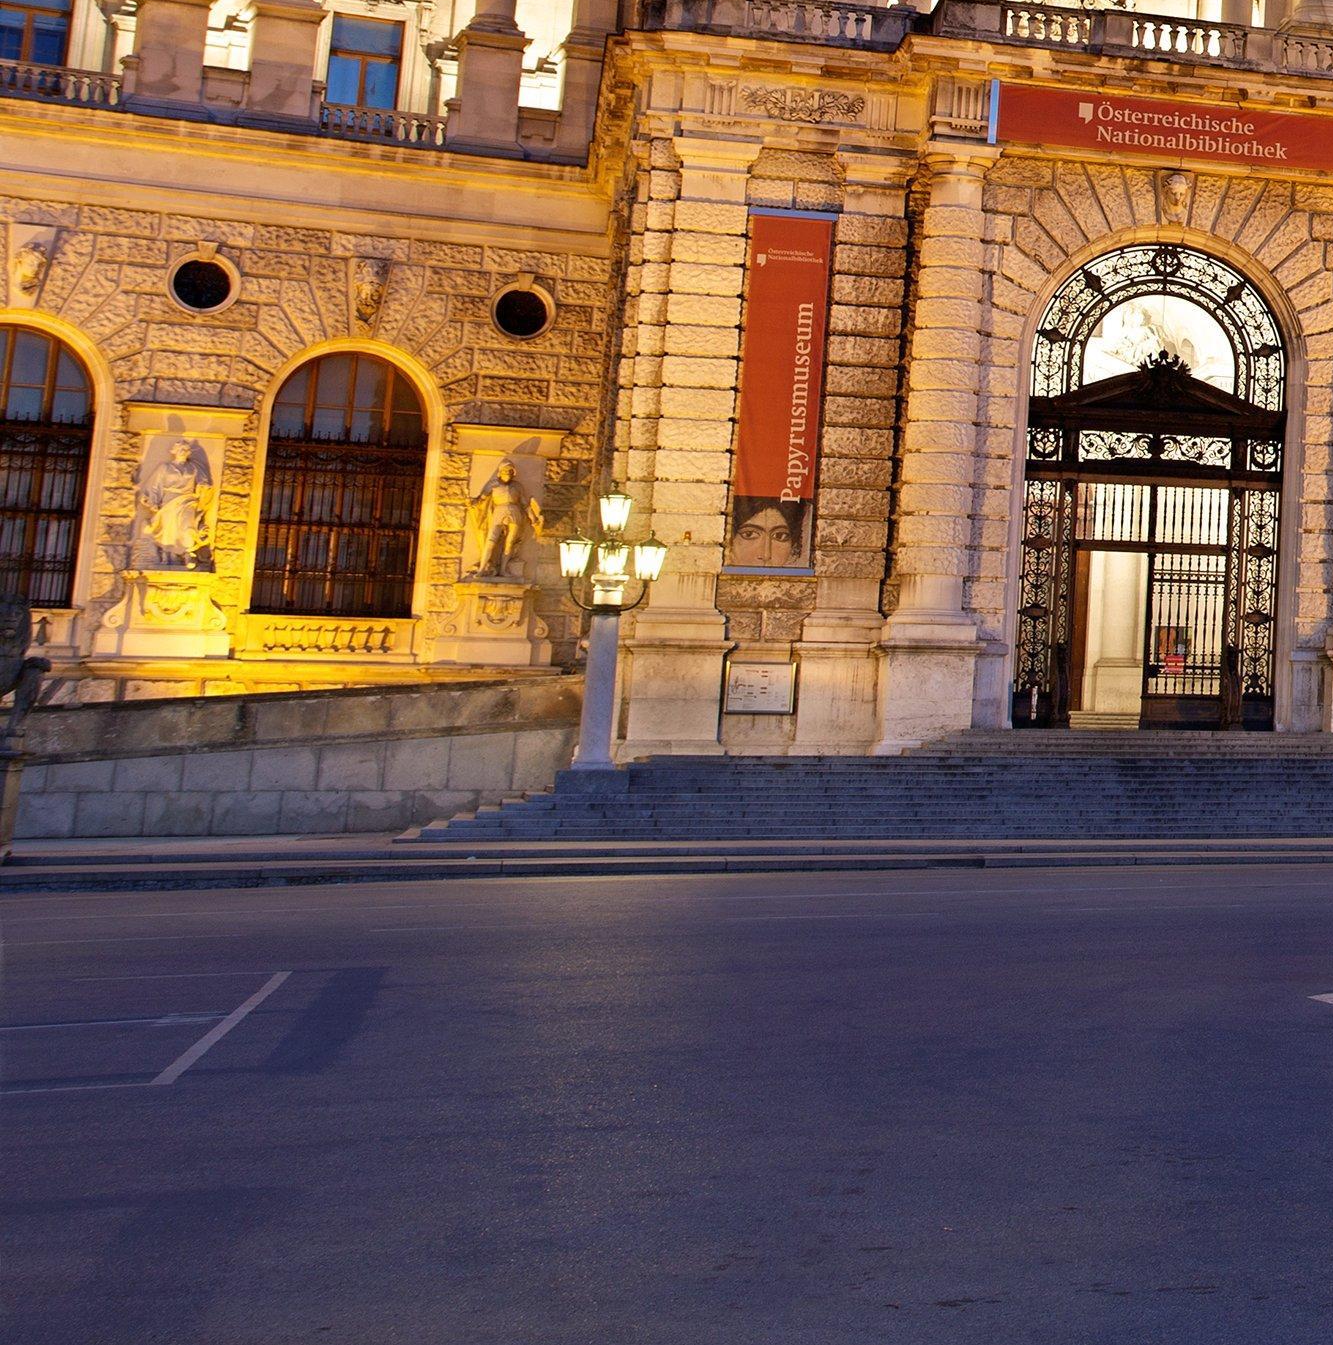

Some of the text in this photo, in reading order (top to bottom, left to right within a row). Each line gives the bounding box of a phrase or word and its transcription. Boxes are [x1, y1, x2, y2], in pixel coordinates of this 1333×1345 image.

[1097, 100, 1255, 136] Österreichische
[1096, 125, 1289, 160] Nationalbibliothek
[780, 301, 815, 504] Papyrusmuseum
